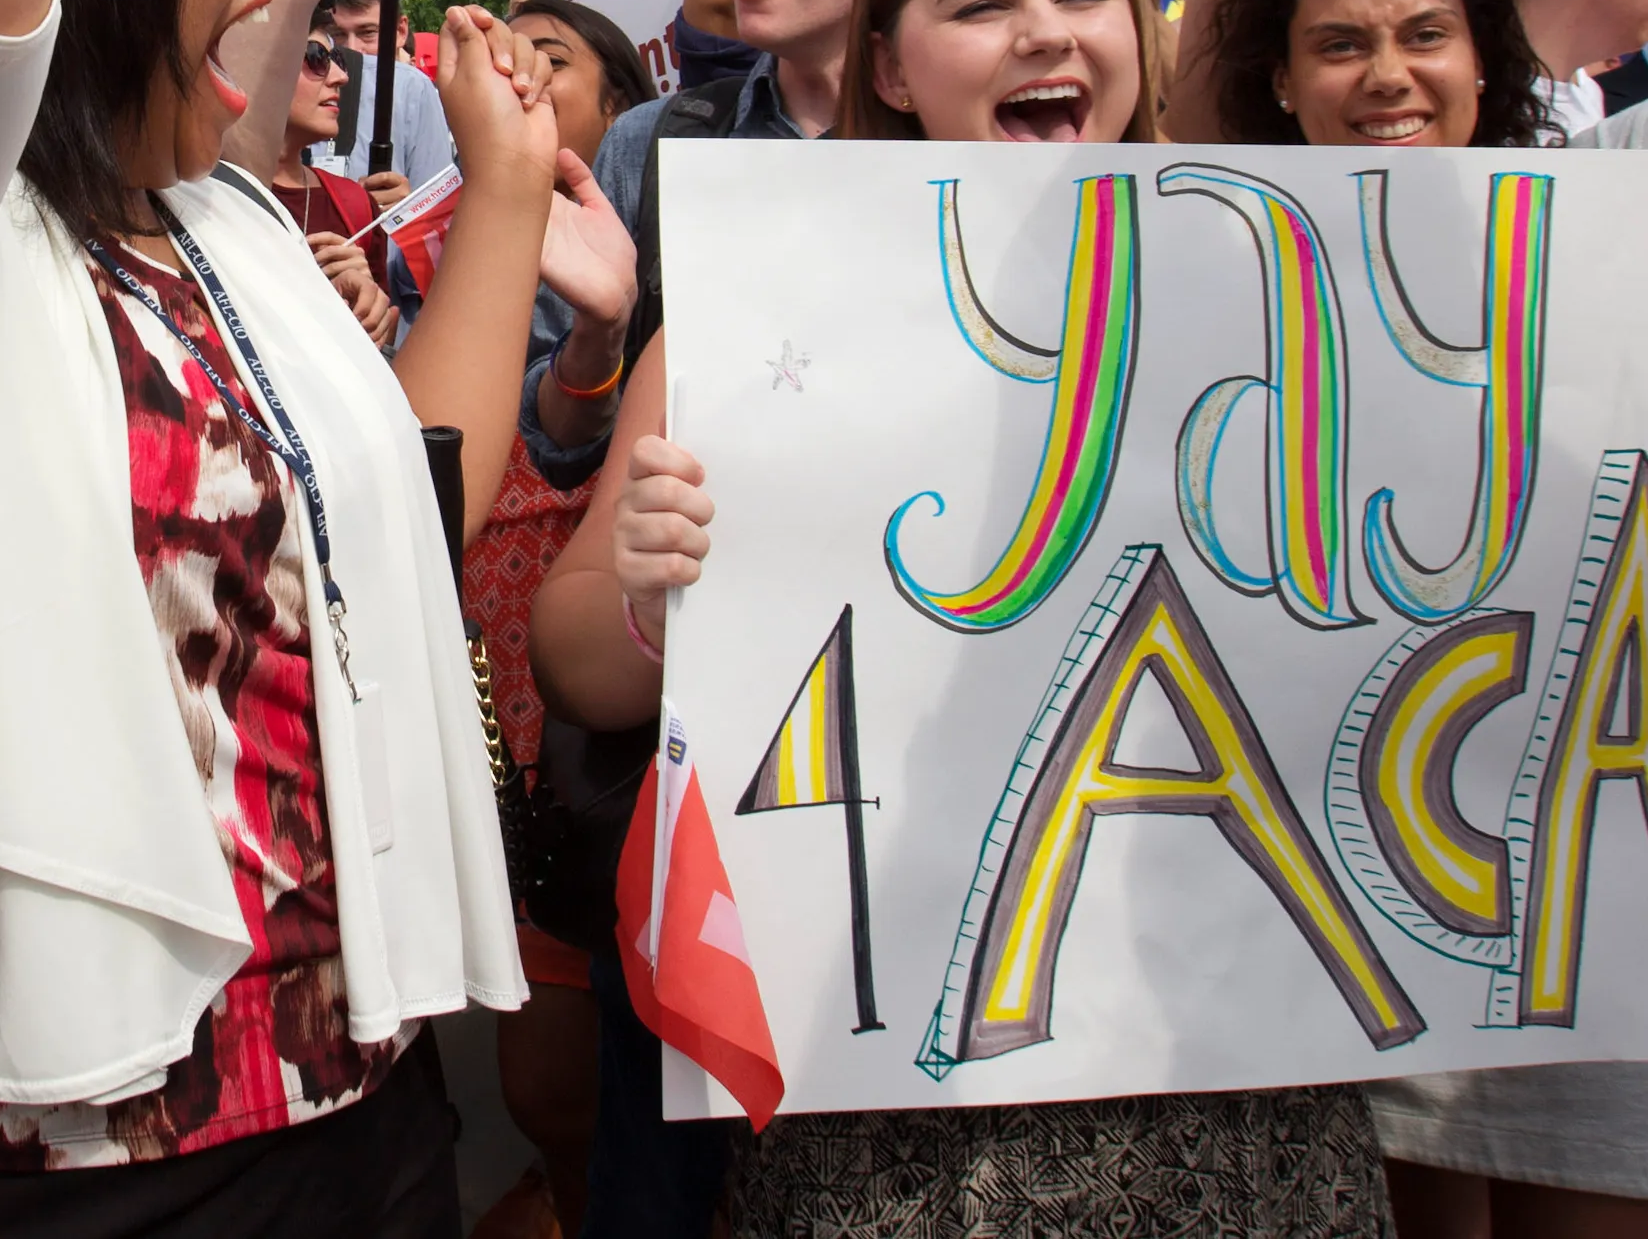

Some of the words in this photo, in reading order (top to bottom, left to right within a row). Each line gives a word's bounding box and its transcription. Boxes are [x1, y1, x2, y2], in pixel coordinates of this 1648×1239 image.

[409, 175, 459, 214] www.hrc.org
[178, 232, 213, 275] AFL-CIO
[115, 267, 167, 317] AFL-CIO
[213, 290, 247, 340] AFL-CIO
[180, 334, 227, 389] AFL-CIO
[248, 357, 283, 410] AFL-CIO
[238, 407, 293, 456] AFL-CIO
